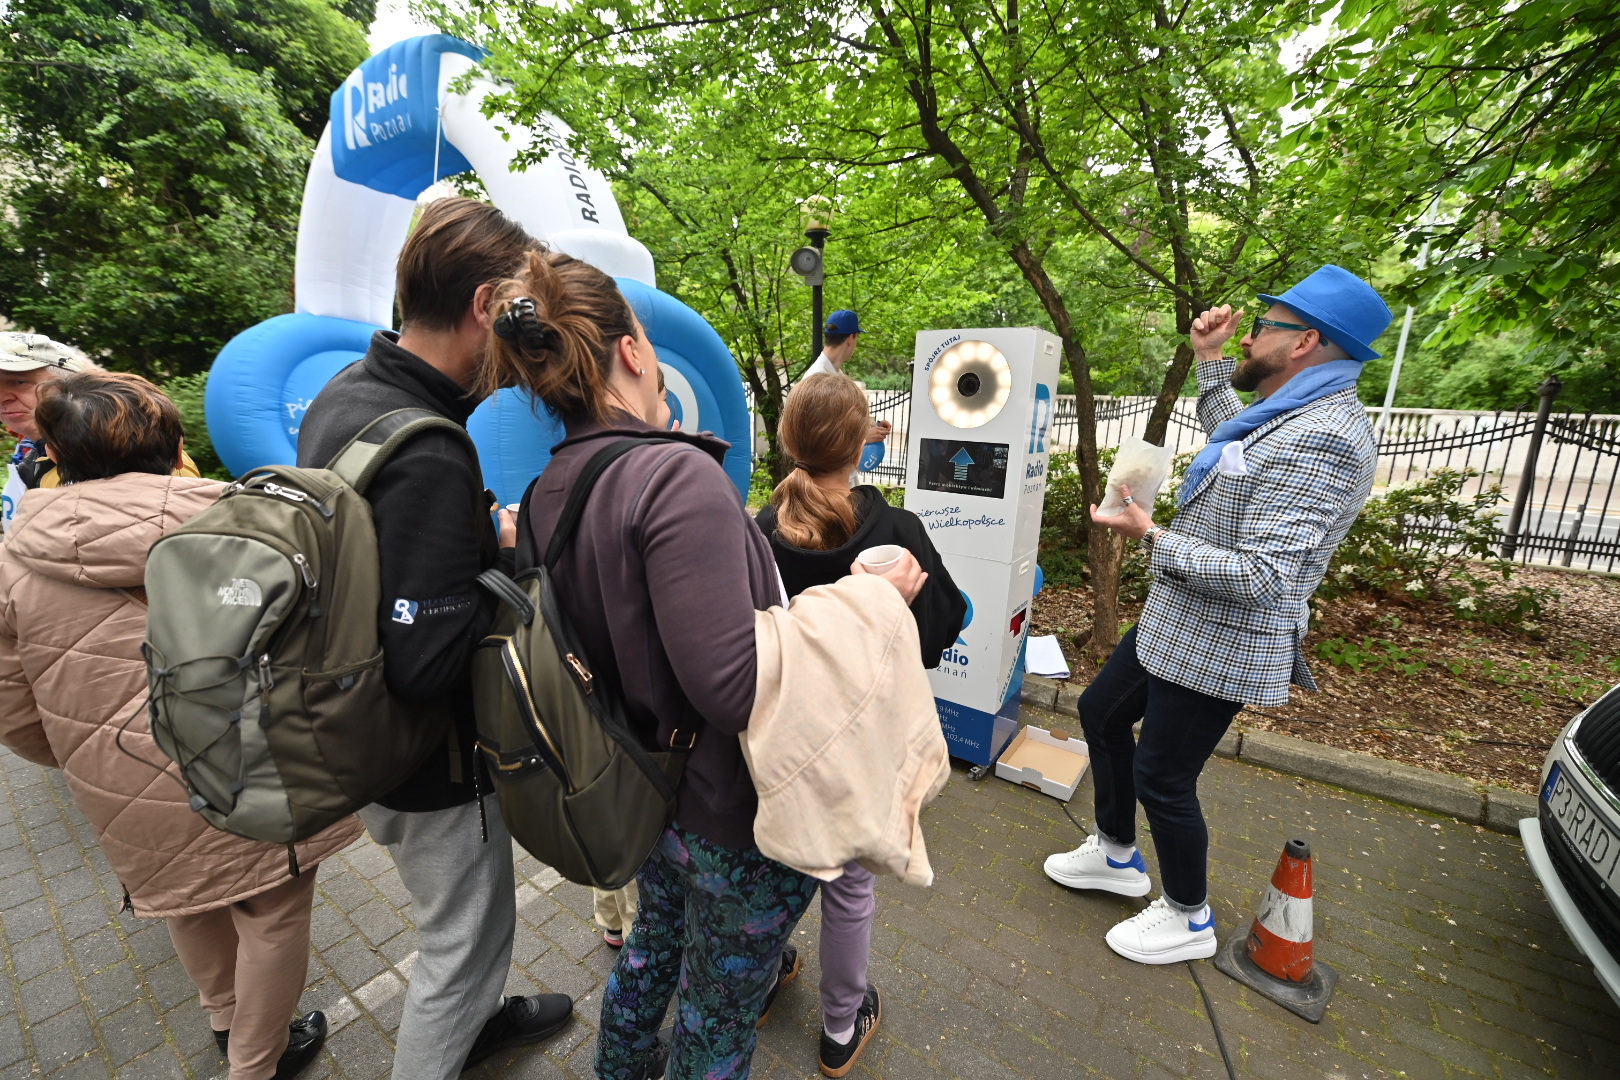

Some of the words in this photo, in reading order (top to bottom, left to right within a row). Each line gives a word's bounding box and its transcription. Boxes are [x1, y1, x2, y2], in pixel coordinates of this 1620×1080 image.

[924, 346, 942, 372] SPÓJRZ
[940, 334, 961, 349] TUTAJ
[1025, 459, 1044, 480] Radio
[928, 514, 1005, 531] Wielkopolsce
[942, 648, 969, 667] dio
[944, 706, 960, 718] MHz
[946, 732, 964, 743] 102,4
[964, 738, 980, 749] MHz
